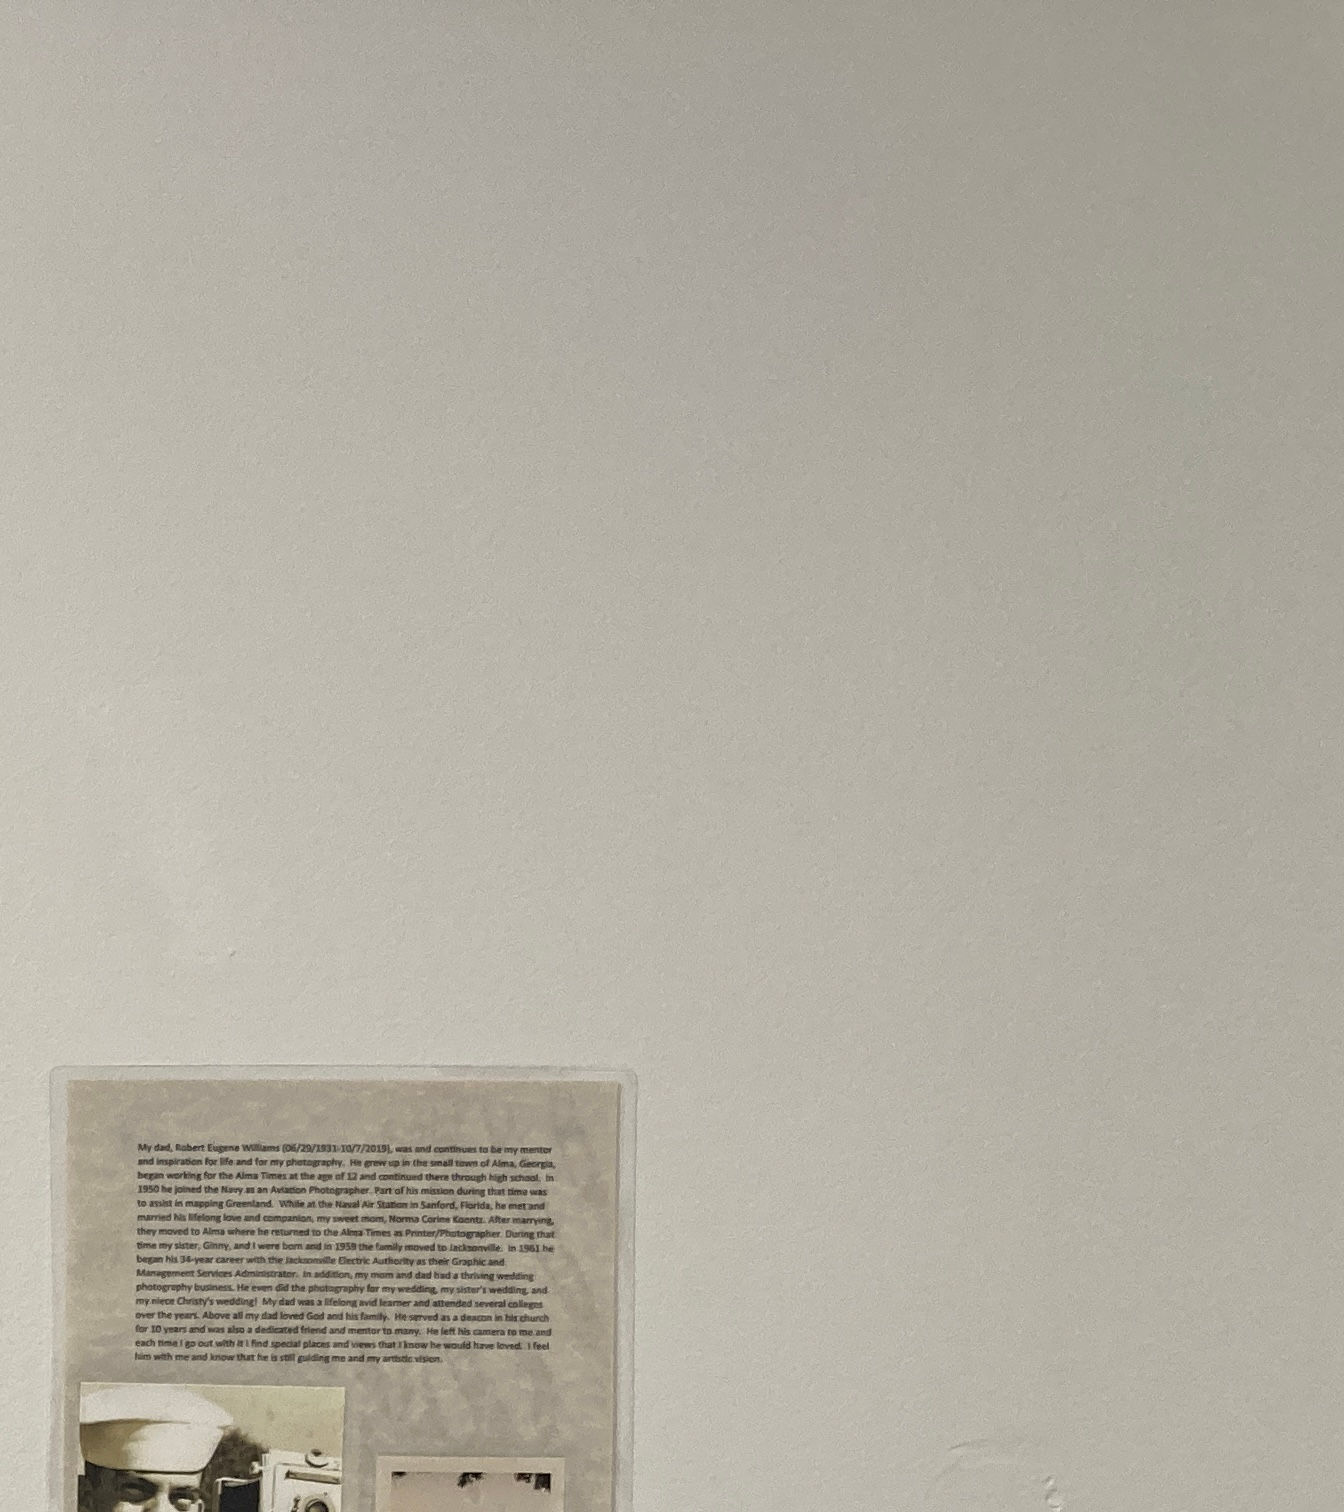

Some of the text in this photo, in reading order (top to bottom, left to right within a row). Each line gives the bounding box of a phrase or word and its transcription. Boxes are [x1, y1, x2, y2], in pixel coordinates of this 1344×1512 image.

[138, 1143, 151, 1152] My
[175, 1143, 205, 1151] Robert
[207, 1143, 239, 1153] Eugene
[414, 1144, 431, 1152] and
[433, 1144, 476, 1152] continues
[504, 1146, 517, 1154] my
[138, 1157, 516, 1168] and inspiration for for grew small of Alma,
[138, 1171, 486, 1182] began working for the Times at age and continued there through
[161, 1185, 171, 1193] he
[174, 1185, 201, 1195] joined
[204, 1185, 218, 1193] the
[395, 1186, 403, 1194] of
[406, 1186, 418, 1194] his
[421, 1186, 454, 1194] mission
[456, 1186, 485, 1196] during
[487, 1186, 505, 1194] that
[138, 1199, 545, 1210] to assist mapping at Naval Sanford, Florida, he met and
[138, 1213, 171, 1221] married
[188, 1213, 220, 1223] lifelong
[223, 1214, 241, 1222] love
[263, 1214, 314, 1224] companion,
[389, 1215, 419, 1223] Norma
[489, 1215, 509, 1223] After
[512, 1215, 554, 1225] marrying,
[137, 1227, 156, 1237] they
[158, 1227, 188, 1235] moved
[202, 1227, 225, 1235] Alma
[227, 1227, 255, 1235] where
[258, 1227, 268, 1236] he
[271, 1228, 309, 1236] returned
[323, 1228, 338, 1236] the
[365, 1228, 391, 1236] Times
[505, 1229, 534, 1239] During
[137, 1241, 156, 1249] time
[175, 1241, 200, 1250] sister,
[252, 1241, 255, 1250] I
[282, 1242, 302, 1250] born
[376, 1242, 402, 1252] family
[405, 1243, 435, 1251] moved
[137, 1255, 163, 1264] began
[285, 1256, 335, 1264] Jacksonville
[338, 1256, 370, 1264] Electric
[428, 1256, 449, 1264] their
[452, 1257, 485, 1266] Graphic
[136, 1269, 194, 1279] Management
[197, 1269, 232, 1277] Services
[355, 1272, 368, 1280] my
[415, 1271, 431, 1279] dad
[460, 1271, 494, 1281] thriving
[496, 1271, 534, 1281] wedding
[136, 1282, 192, 1292] photography
[237, 1283, 248, 1291] He
[291, 1283, 305, 1292] the
[308, 1284, 364, 1294] photography
[488, 1285, 528, 1295] wedding,
[136, 1298, 149, 1306] my
[151, 1297, 174, 1305] niece
[262, 1297, 276, 1307] My
[279, 1298, 295, 1306] dad
[324, 1298, 356, 1308] lifelong
[379, 1298, 411, 1306] learner
[413, 1299, 430, 1307] and
[432, 1299, 472, 1307] attended
[475, 1299, 505, 1307] several
[157, 1310, 172, 1318] the
[202, 1311, 230, 1319] Above
[232, 1311, 242, 1319] all
[245, 1313, 258, 1321] my
[280, 1311, 304, 1319] loved
[409, 1312, 438, 1320] served
[460, 1313, 492, 1321] deacon
[519, 1313, 549, 1321] church
[136, 1324, 148, 1332] for
[163, 1326, 186, 1334] years
[189, 1324, 205, 1333] and
[255, 1325, 298, 1333] dedicated
[300, 1325, 326, 1333] friend
[329, 1325, 345, 1334] and
[348, 1326, 380, 1334] mentor
[383, 1326, 392, 1334] to
[394, 1328, 421, 1336] many.
[535, 1327, 551, 1335] and
[135, 1338, 549, 1349] each I out special places and know he would have feel
[135, 1352, 151, 1360] him
[191, 1352, 208, 1360] and
[210, 1352, 234, 1360] know
[257, 1353, 268, 1361] he
[348, 1353, 364, 1361] and
[382, 1354, 412, 1362] artistic
